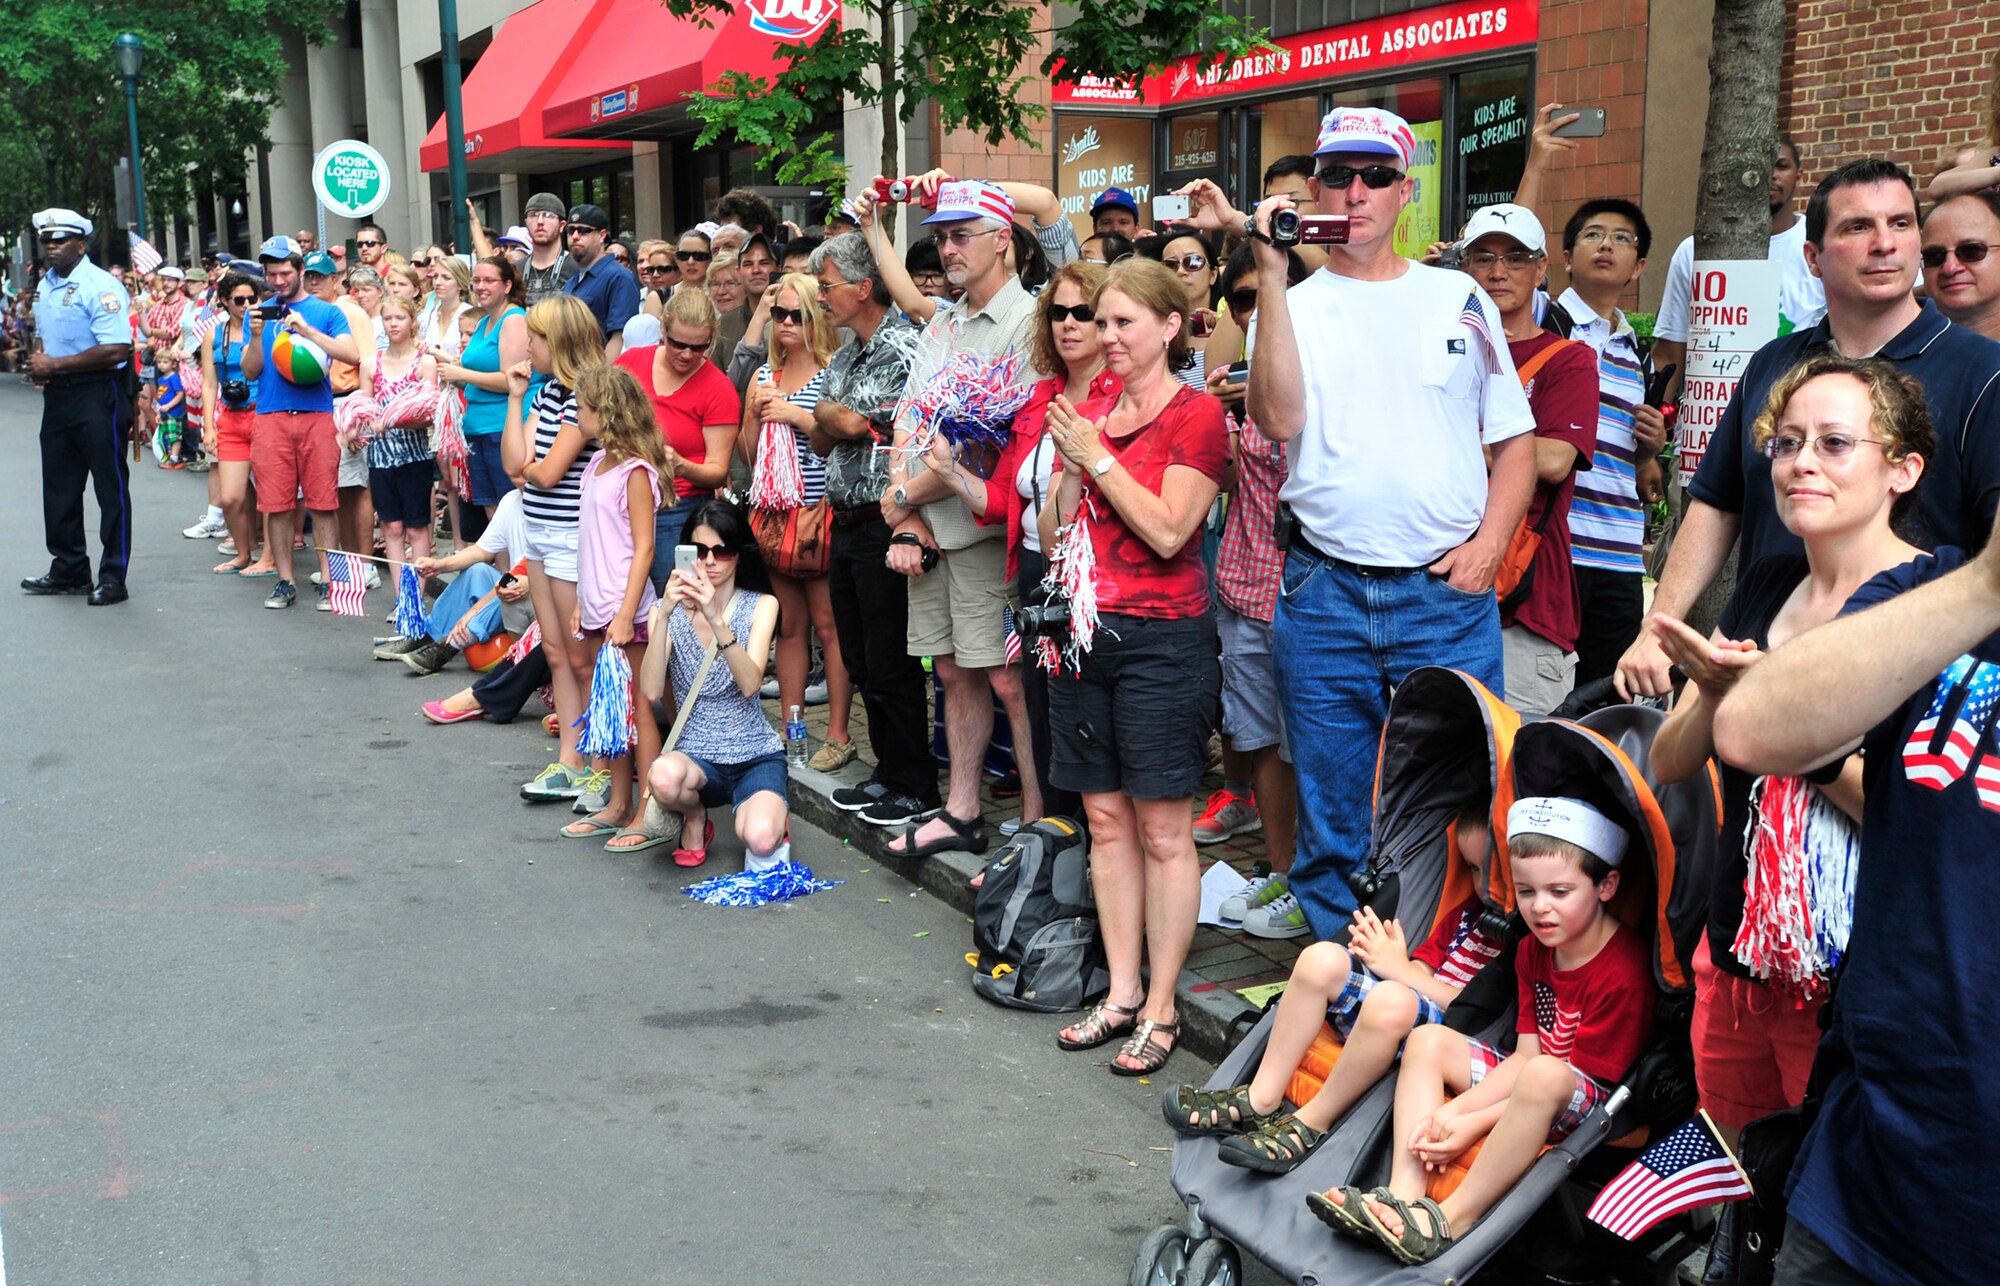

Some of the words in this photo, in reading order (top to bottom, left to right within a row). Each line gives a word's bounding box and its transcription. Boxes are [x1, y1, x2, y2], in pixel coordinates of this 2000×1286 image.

[1301, 35, 1371, 68] DENTAL
[1380, 8, 1507, 54] ASSOCIATES
[1080, 75, 1131, 88] DENTL
[1474, 103, 1495, 127] KIDS
[1498, 95, 1516, 120] ARE
[1183, 127, 1208, 151] 607
[1460, 133, 1478, 155] OUR
[1481, 115, 1528, 149] SPECIALTY
[327, 166, 378, 180] LOCATED
[335, 155, 370, 168] KIOSK
[338, 177, 368, 189] HERE
[1079, 168, 1106, 189] KIDS
[1111, 163, 1134, 183] ARE
[1061, 194, 1085, 214] OUR
[1090, 184, 1150, 210] SPLTY
[1468, 191, 1515, 205] PEDIATRIC
[1690, 271, 1727, 302] NO
[1689, 306, 1748, 326] OPPING
[1683, 404, 1727, 426] OLICE
